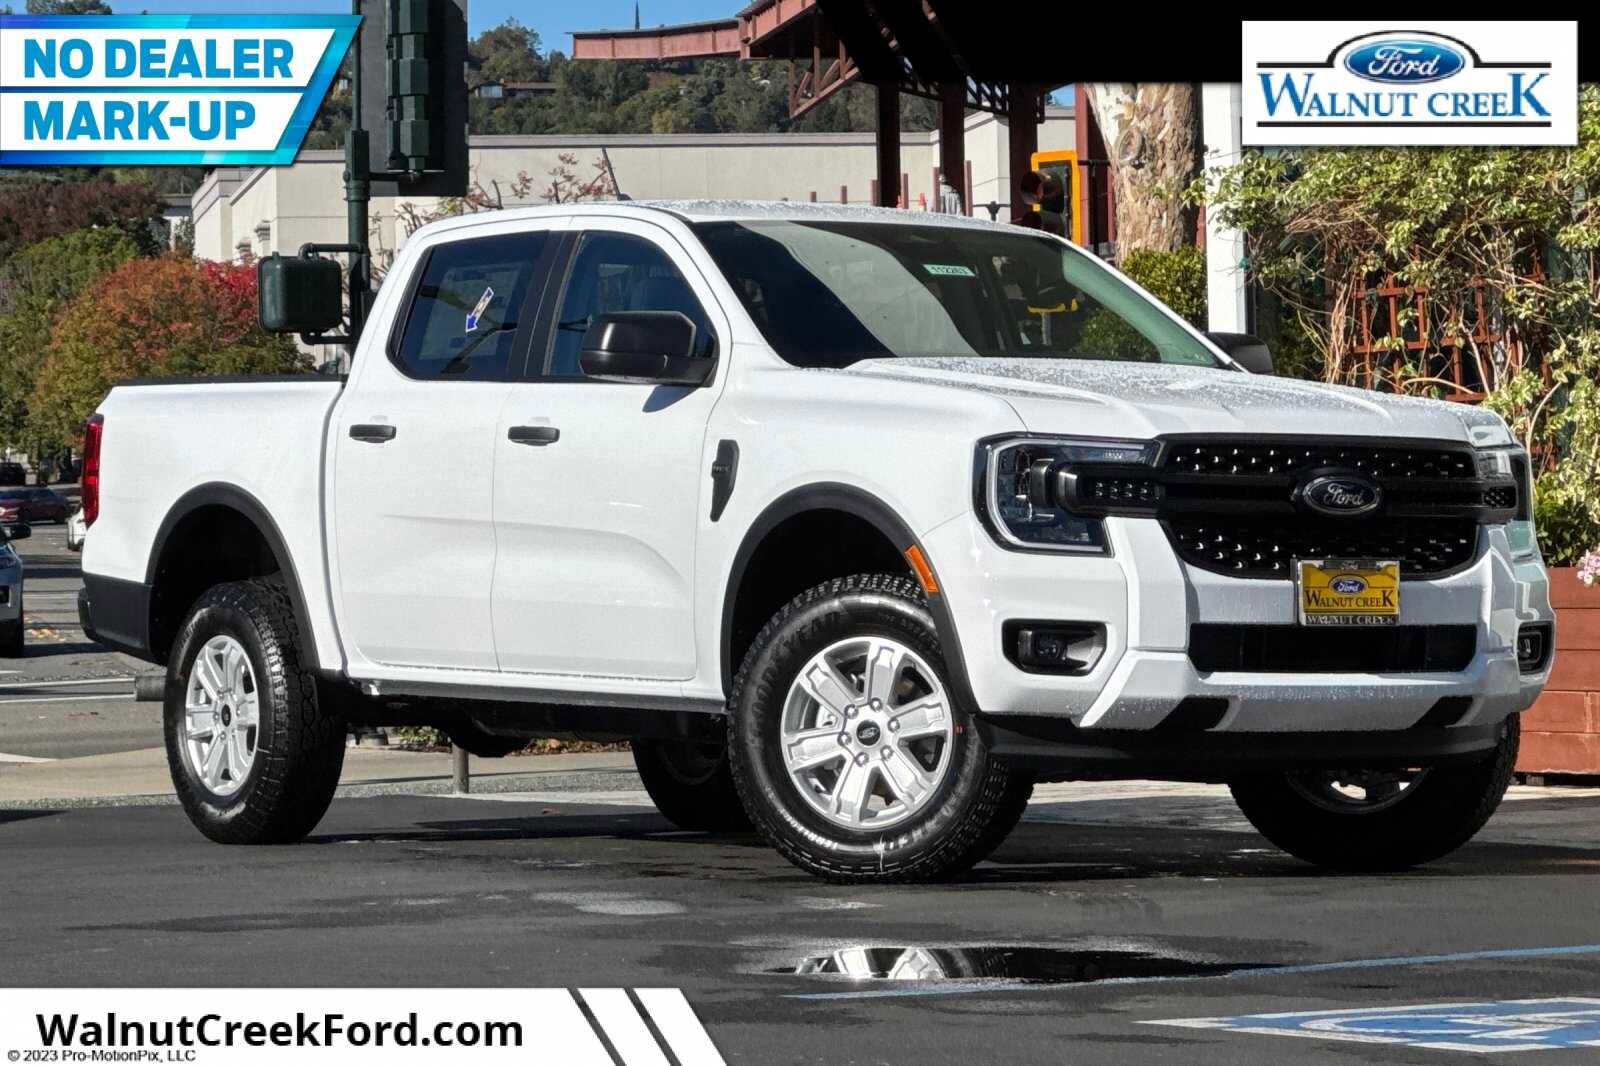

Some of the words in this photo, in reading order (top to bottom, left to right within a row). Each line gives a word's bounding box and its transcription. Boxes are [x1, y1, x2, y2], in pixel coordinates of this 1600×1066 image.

[1322, 482, 1365, 506] Ford
[1337, 581, 1360, 592] Ford
[1305, 590, 1354, 608] WALNUT
[1355, 590, 1395, 608] CREEK
[1307, 615, 1354, 625] WALNUT
[1356, 615, 1395, 625] CREEK
